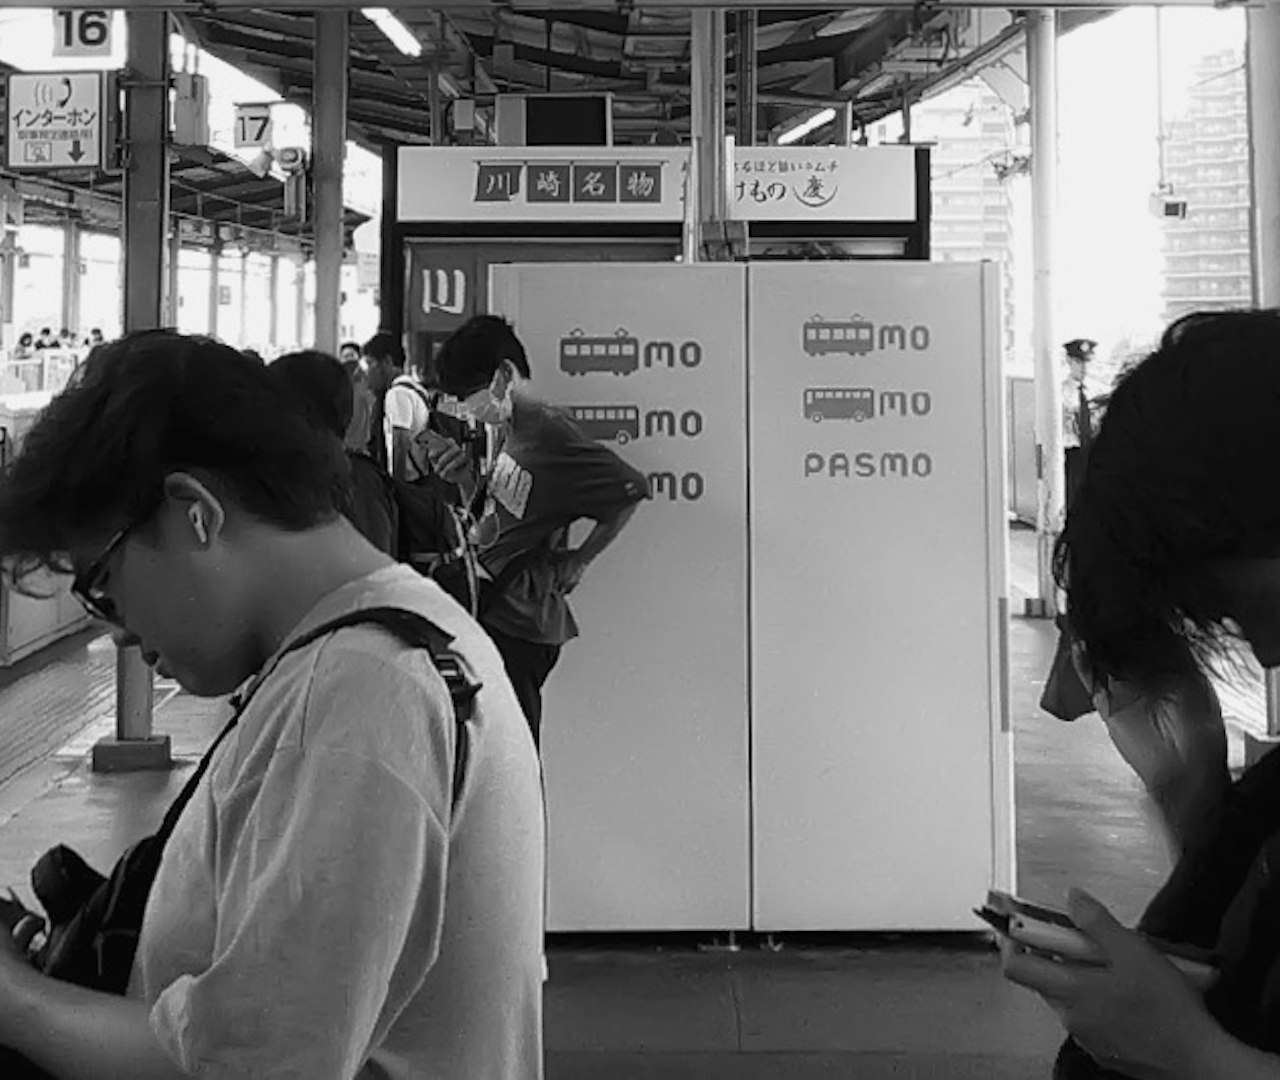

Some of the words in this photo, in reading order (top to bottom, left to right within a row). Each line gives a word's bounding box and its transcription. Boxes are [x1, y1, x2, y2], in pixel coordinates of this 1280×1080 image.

[57, 11, 108, 48] 16
[12, 107, 97, 128] インターホン
[239, 116, 270, 142] 17
[486, 171, 656, 199] 川崎名物
[804, 451, 934, 477] PASMO
